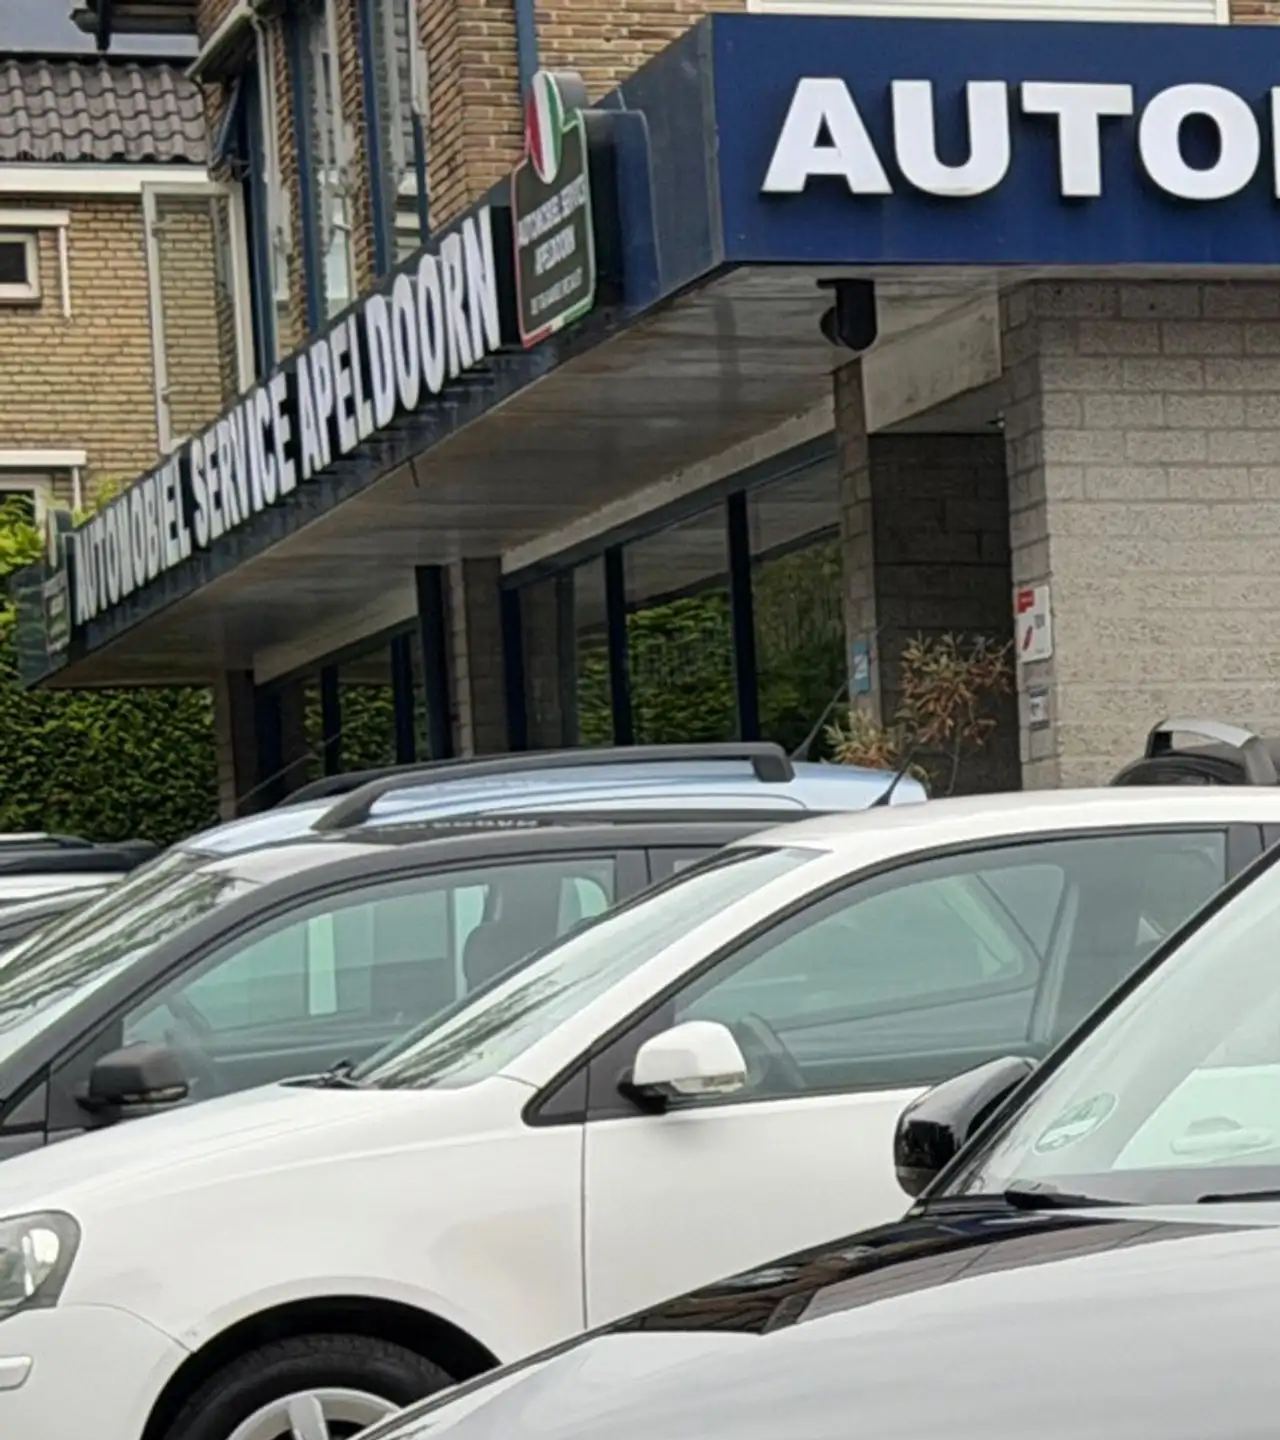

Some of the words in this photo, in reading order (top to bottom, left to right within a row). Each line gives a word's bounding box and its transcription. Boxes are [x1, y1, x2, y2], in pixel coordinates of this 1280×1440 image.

[75, 450, 191, 625] AUTOMOBIEL
[189, 372, 297, 549] SERVICE
[297, 204, 501, 480] APELDOORN
